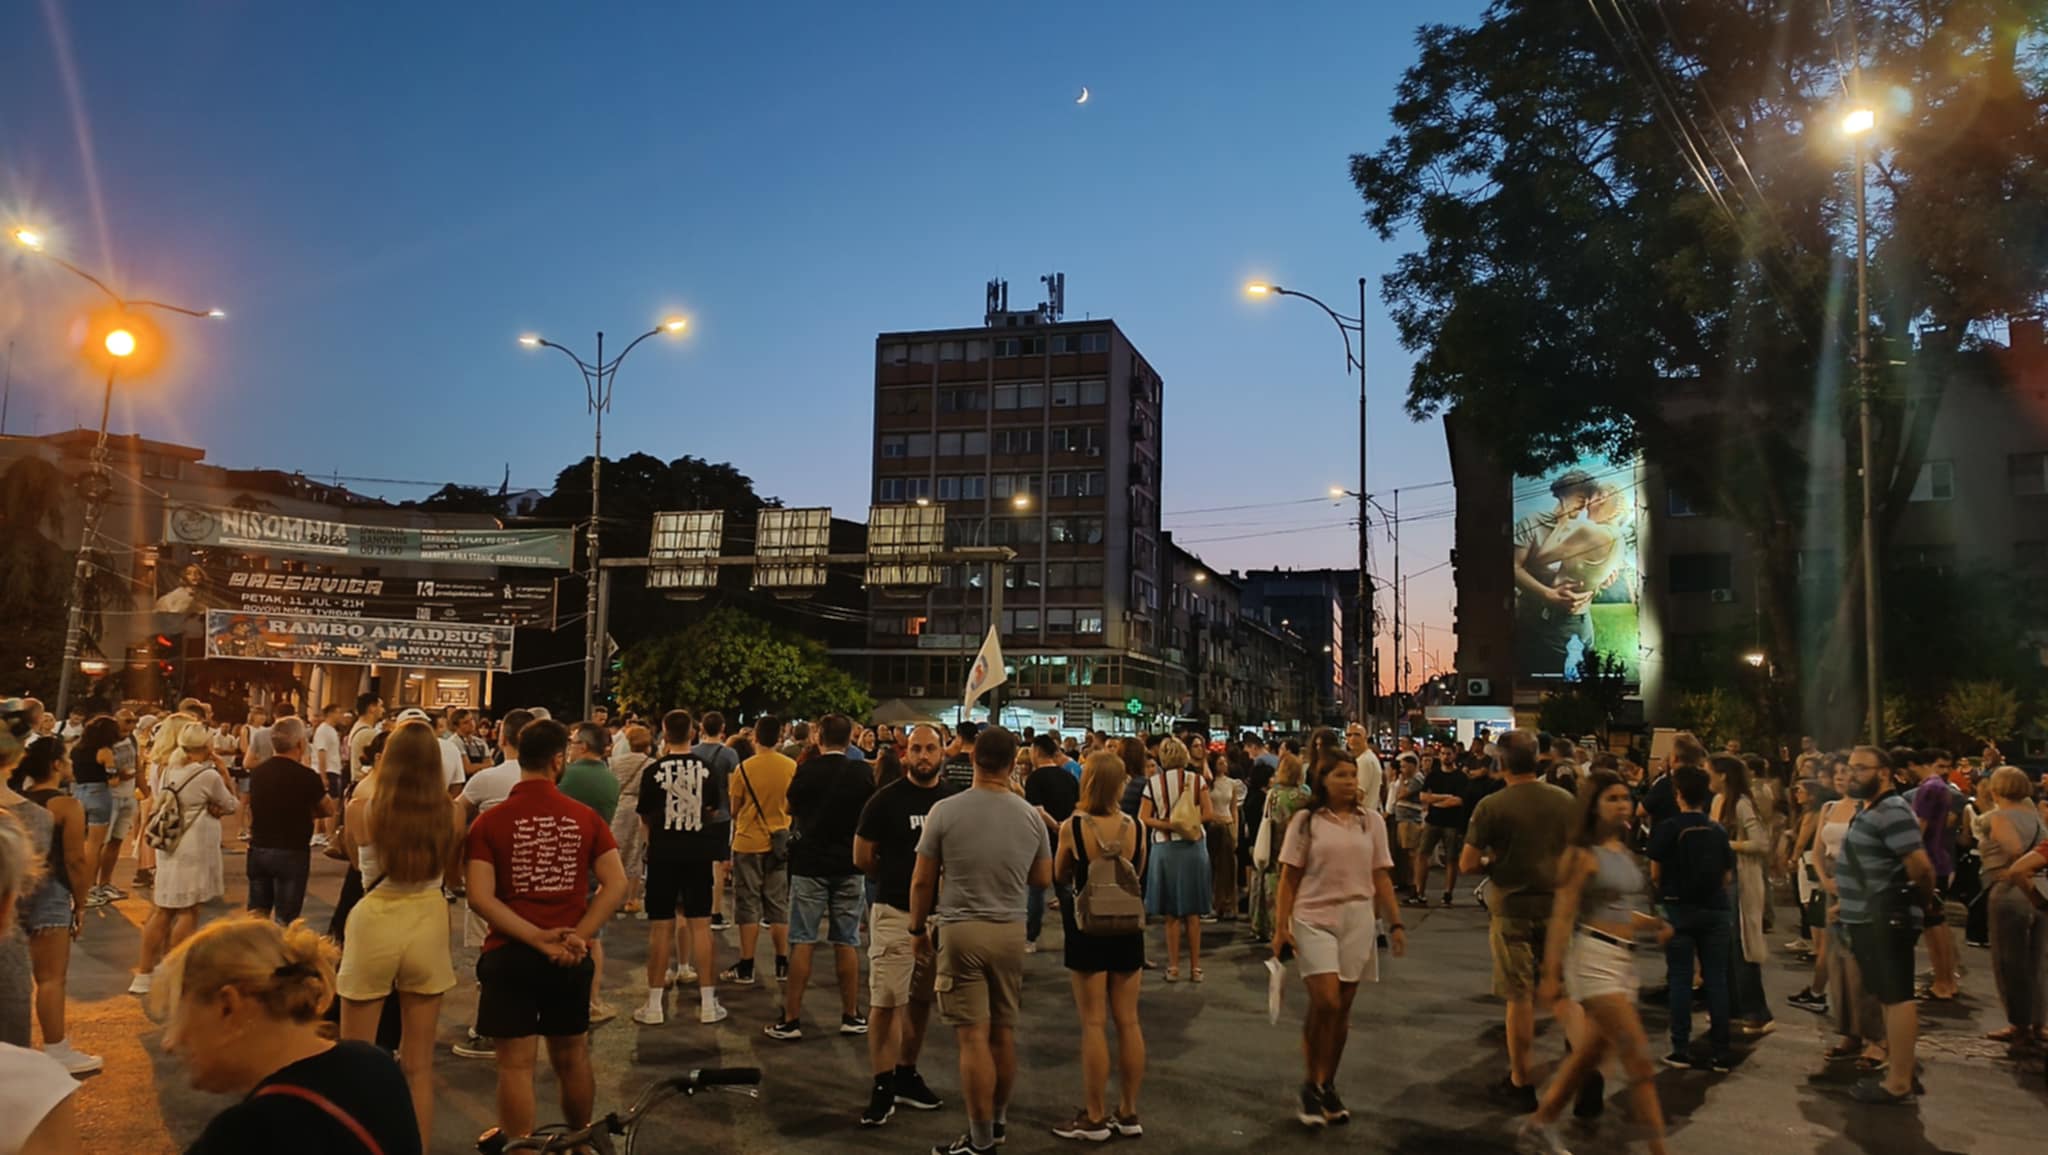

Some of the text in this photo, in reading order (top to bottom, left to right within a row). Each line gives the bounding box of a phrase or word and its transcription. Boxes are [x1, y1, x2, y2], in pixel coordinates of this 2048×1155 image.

[241, 593, 286, 605] PETAK,
[308, 597, 332, 607] JUL
[342, 599, 365, 608] 21H
[268, 620, 494, 644] RAMBO AMADEUS
